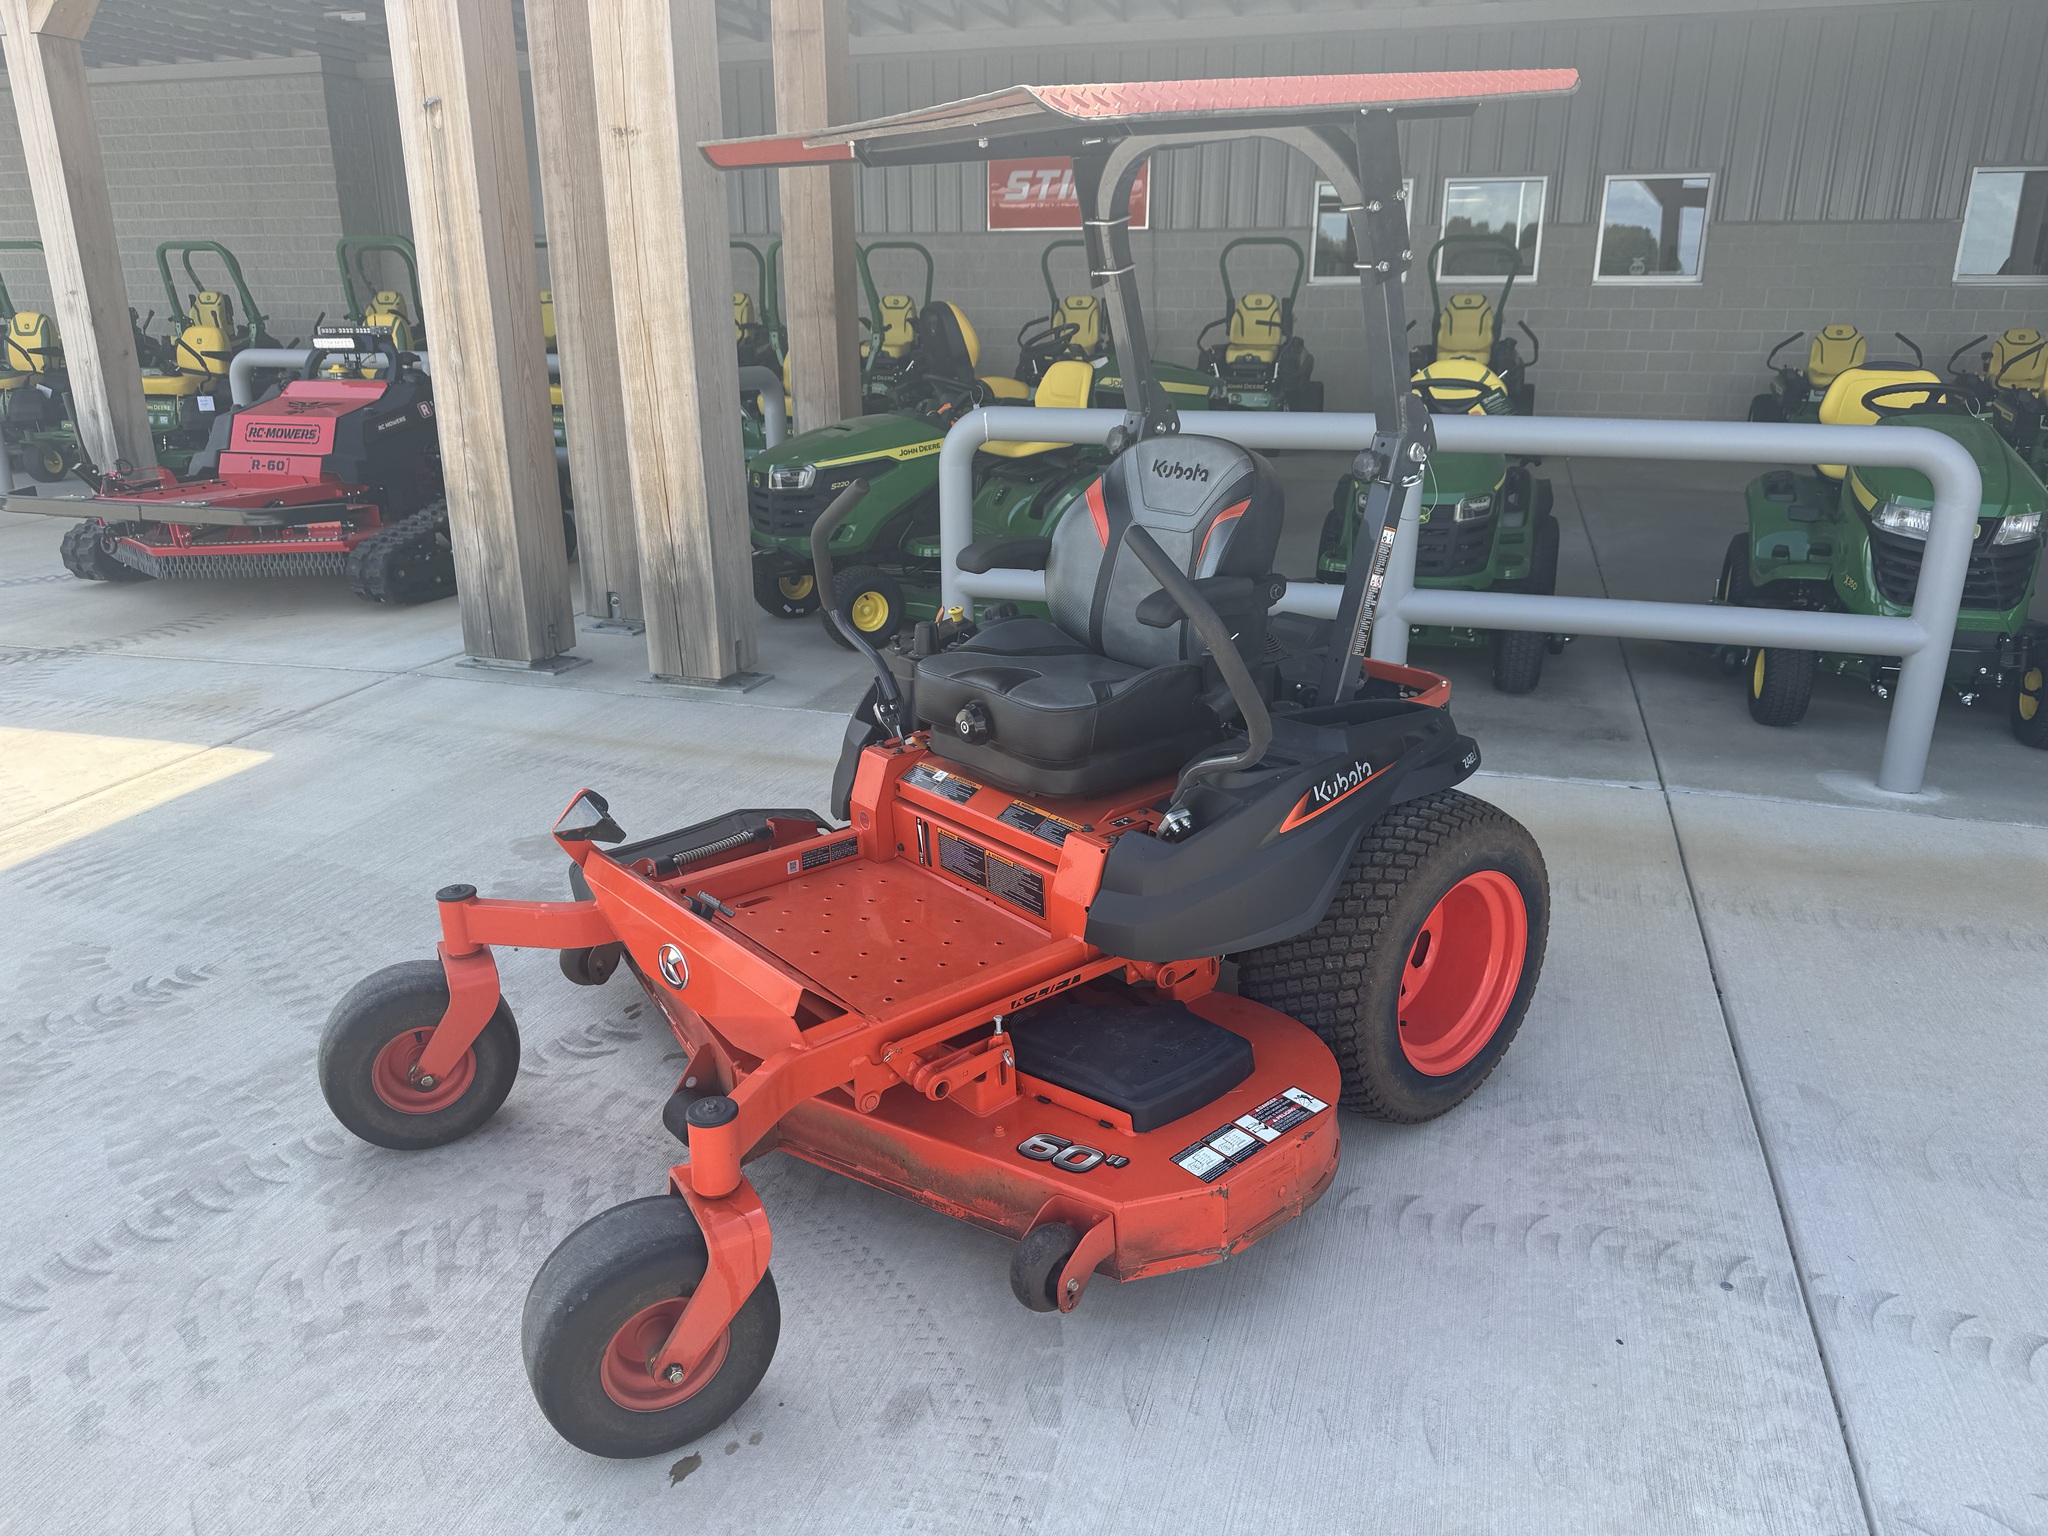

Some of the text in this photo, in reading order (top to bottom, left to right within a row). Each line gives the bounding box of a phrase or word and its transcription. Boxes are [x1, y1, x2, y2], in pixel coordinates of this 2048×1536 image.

[1004, 169, 1079, 201] STI
[899, 442, 941, 457] JOHN DEERE
[251, 459, 286, 471] R-60
[1151, 459, 1210, 482] Kubota
[1313, 761, 1373, 802] Kubota
